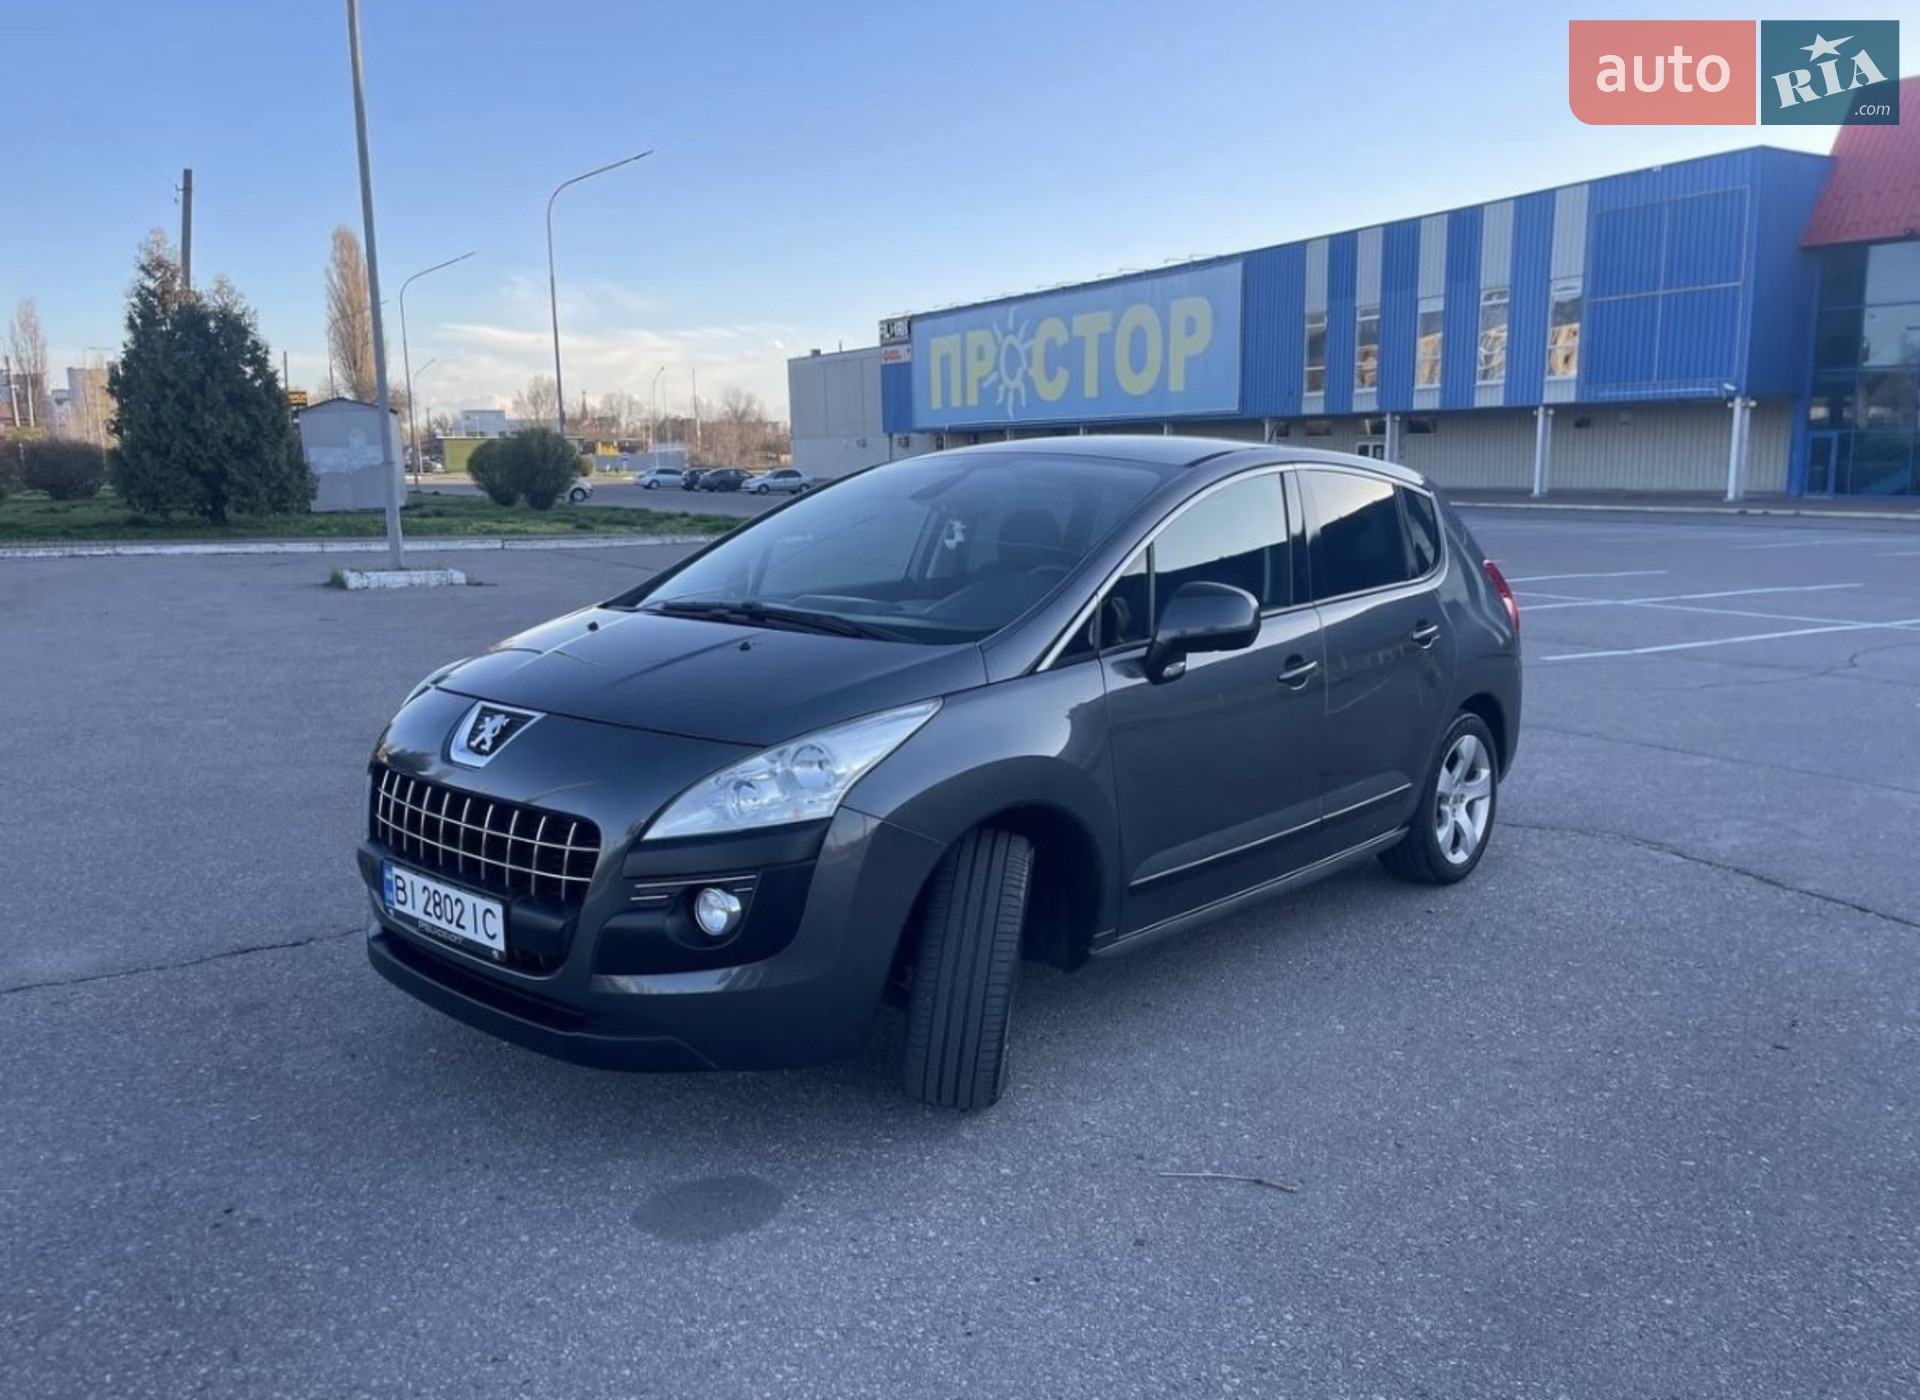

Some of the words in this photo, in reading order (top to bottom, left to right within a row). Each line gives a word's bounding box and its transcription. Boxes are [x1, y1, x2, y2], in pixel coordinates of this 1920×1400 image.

[929, 296, 1213, 416] ПРОСТОР
[394, 874, 416, 911] BI
[421, 885, 467, 931] 2802
[472, 902, 498, 941] IC
